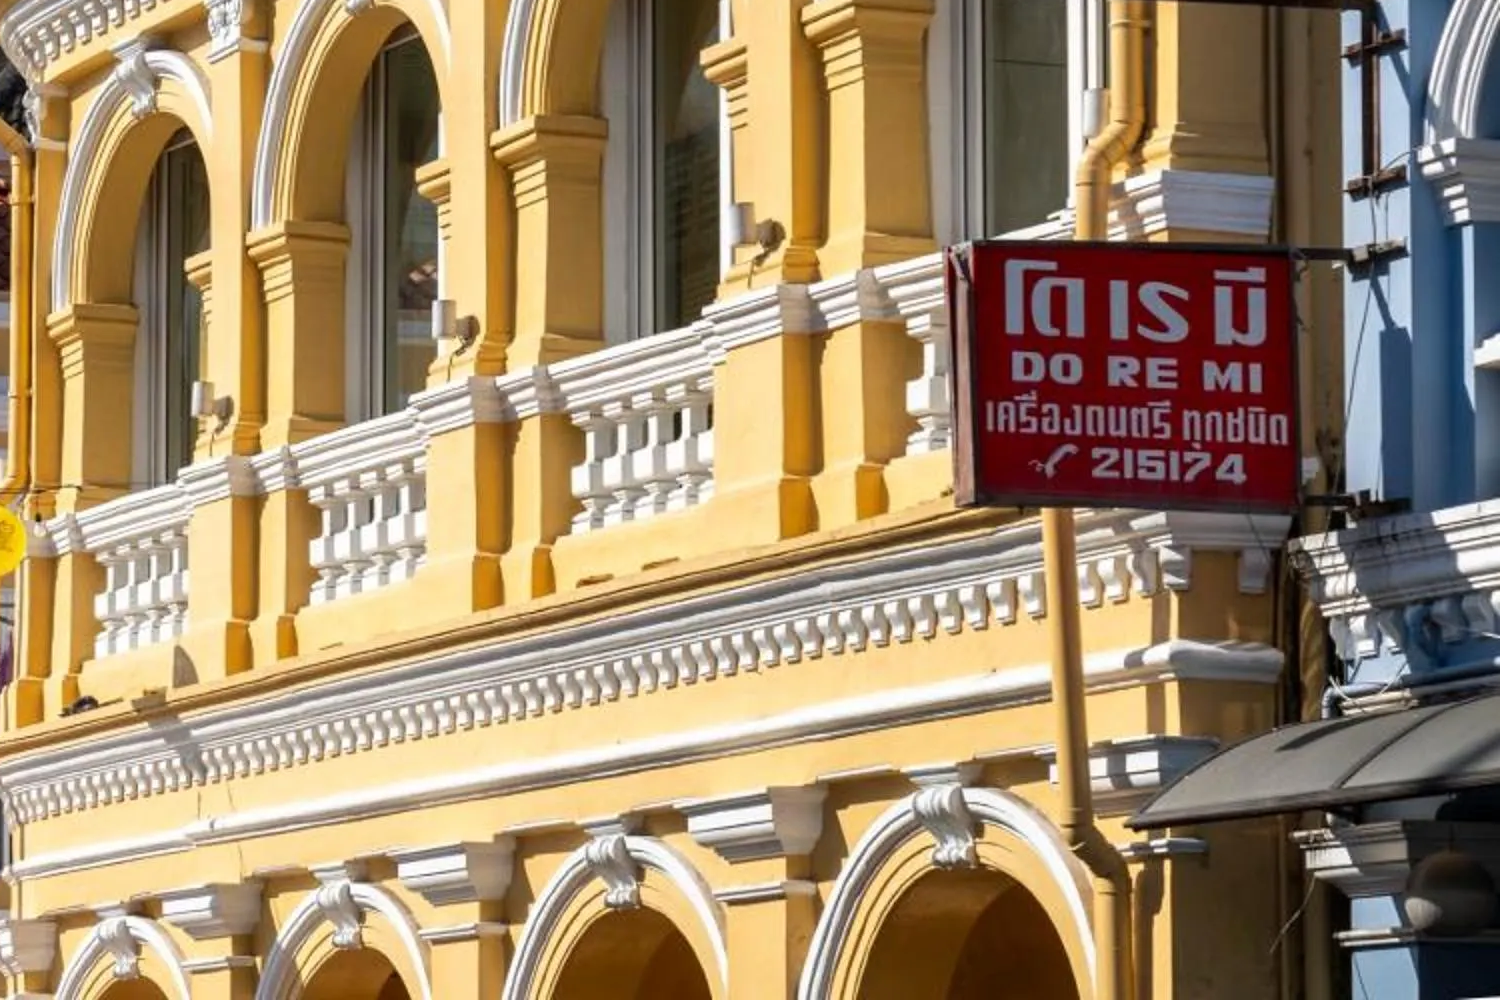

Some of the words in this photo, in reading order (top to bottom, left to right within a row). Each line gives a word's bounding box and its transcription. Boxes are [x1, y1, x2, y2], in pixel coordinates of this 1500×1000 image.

[1004, 258, 1085, 338] โด
[1109, 279, 1190, 343] เร
[1213, 266, 1267, 347] มี
[1011, 350, 1083, 385] DO
[1107, 355, 1179, 390] RE
[1202, 360, 1263, 394] MI
[985, 389, 1172, 440] เครื่องดนตรี
[1090, 447, 1248, 485] 215174
